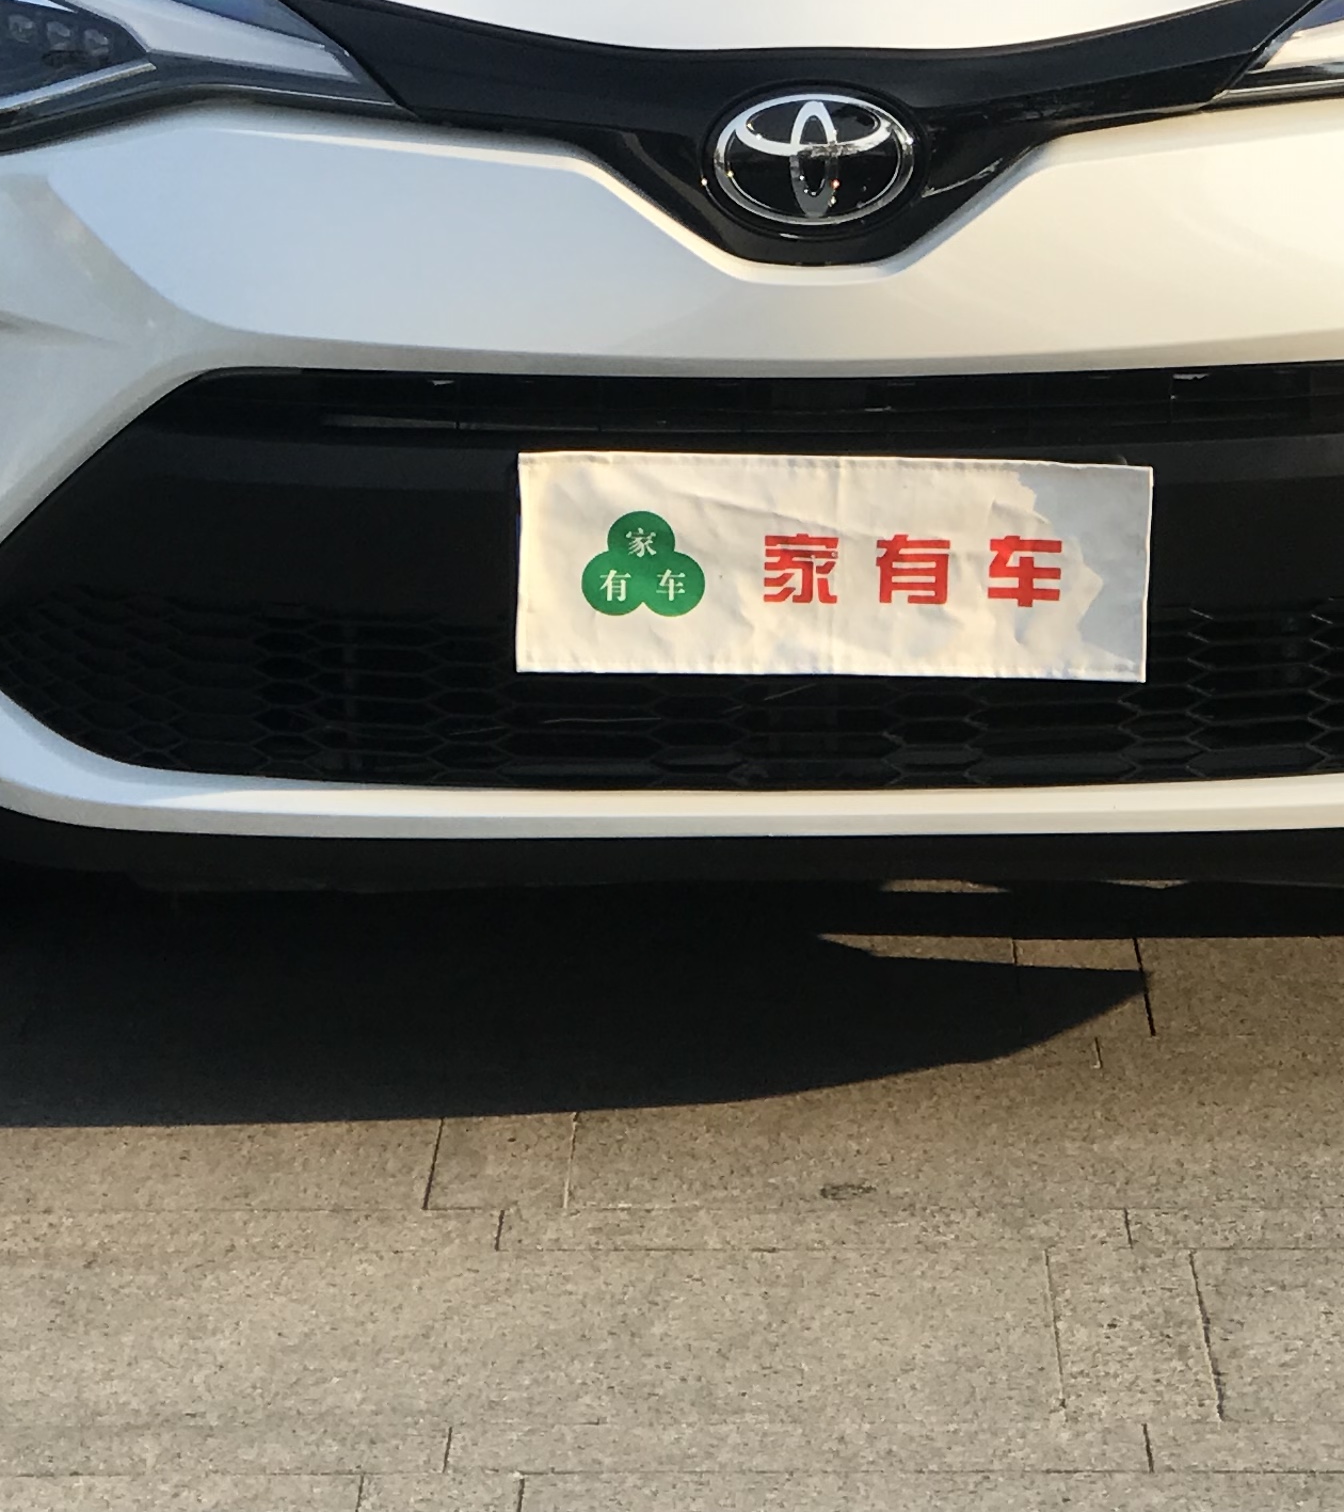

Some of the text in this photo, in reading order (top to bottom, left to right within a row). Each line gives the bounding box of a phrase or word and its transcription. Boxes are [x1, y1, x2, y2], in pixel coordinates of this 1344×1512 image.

[624, 526, 658, 558] 家
[764, 533, 1062, 607] 家有车
